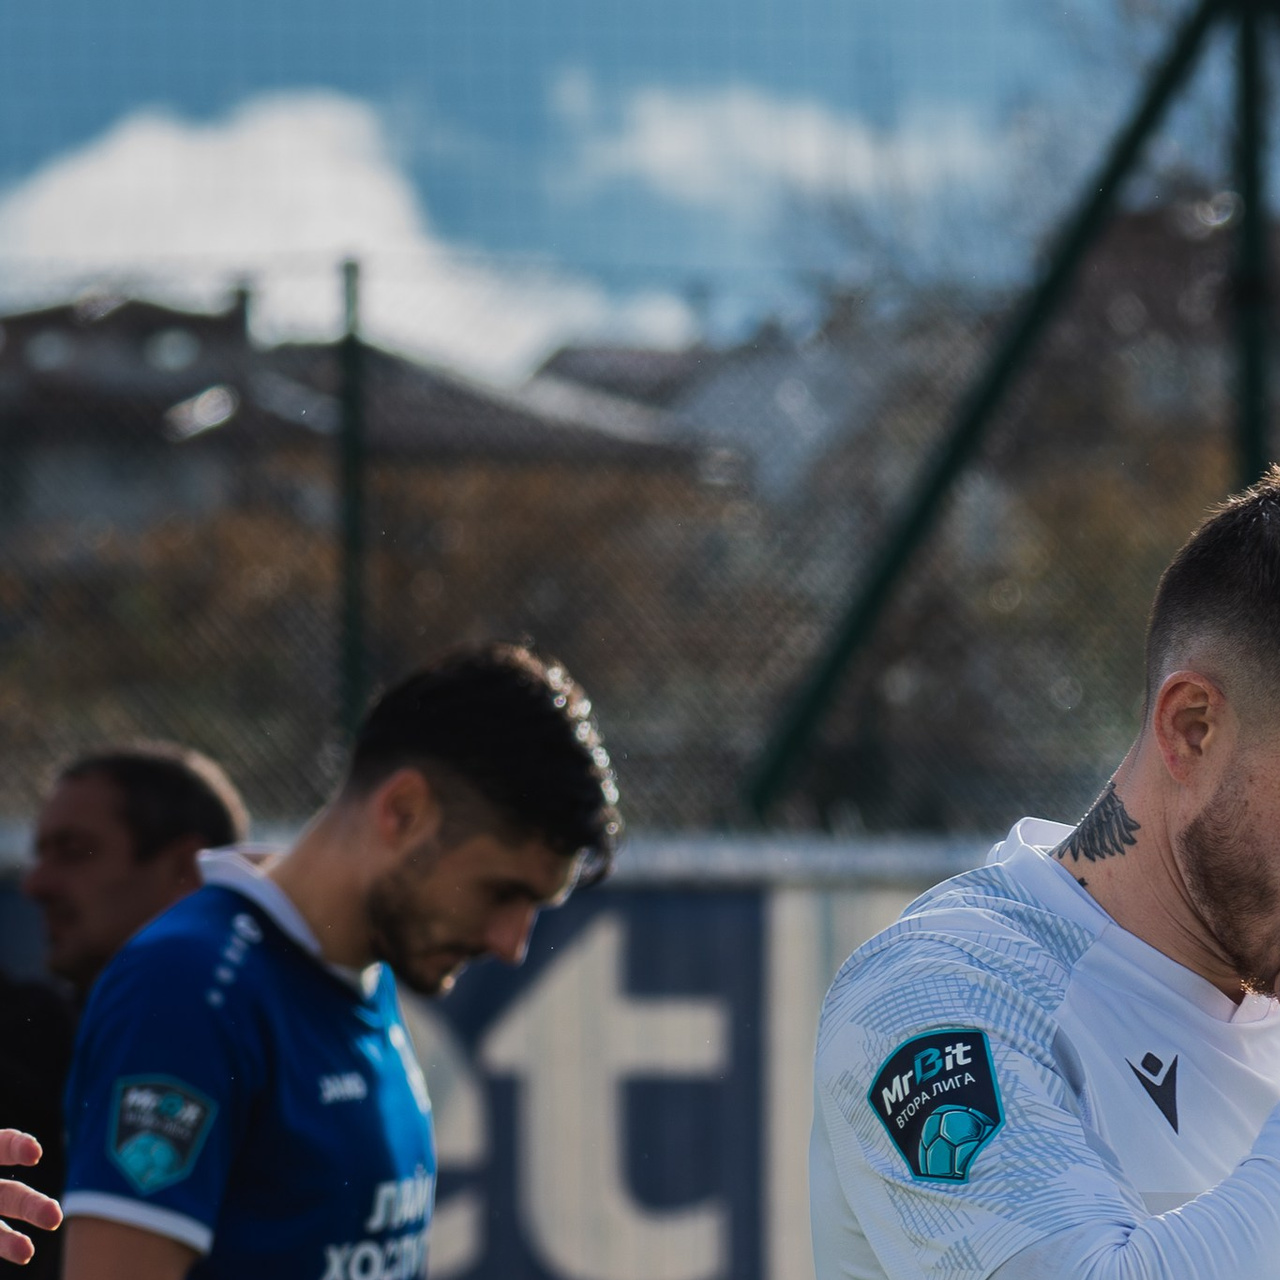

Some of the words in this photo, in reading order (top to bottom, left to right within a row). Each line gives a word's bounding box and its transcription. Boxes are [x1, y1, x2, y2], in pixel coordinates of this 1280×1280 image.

[881, 1042, 972, 1116] MrBit
[895, 1091, 931, 1129] ВТОРА
[931, 1072, 976, 1098] ЛИГА
